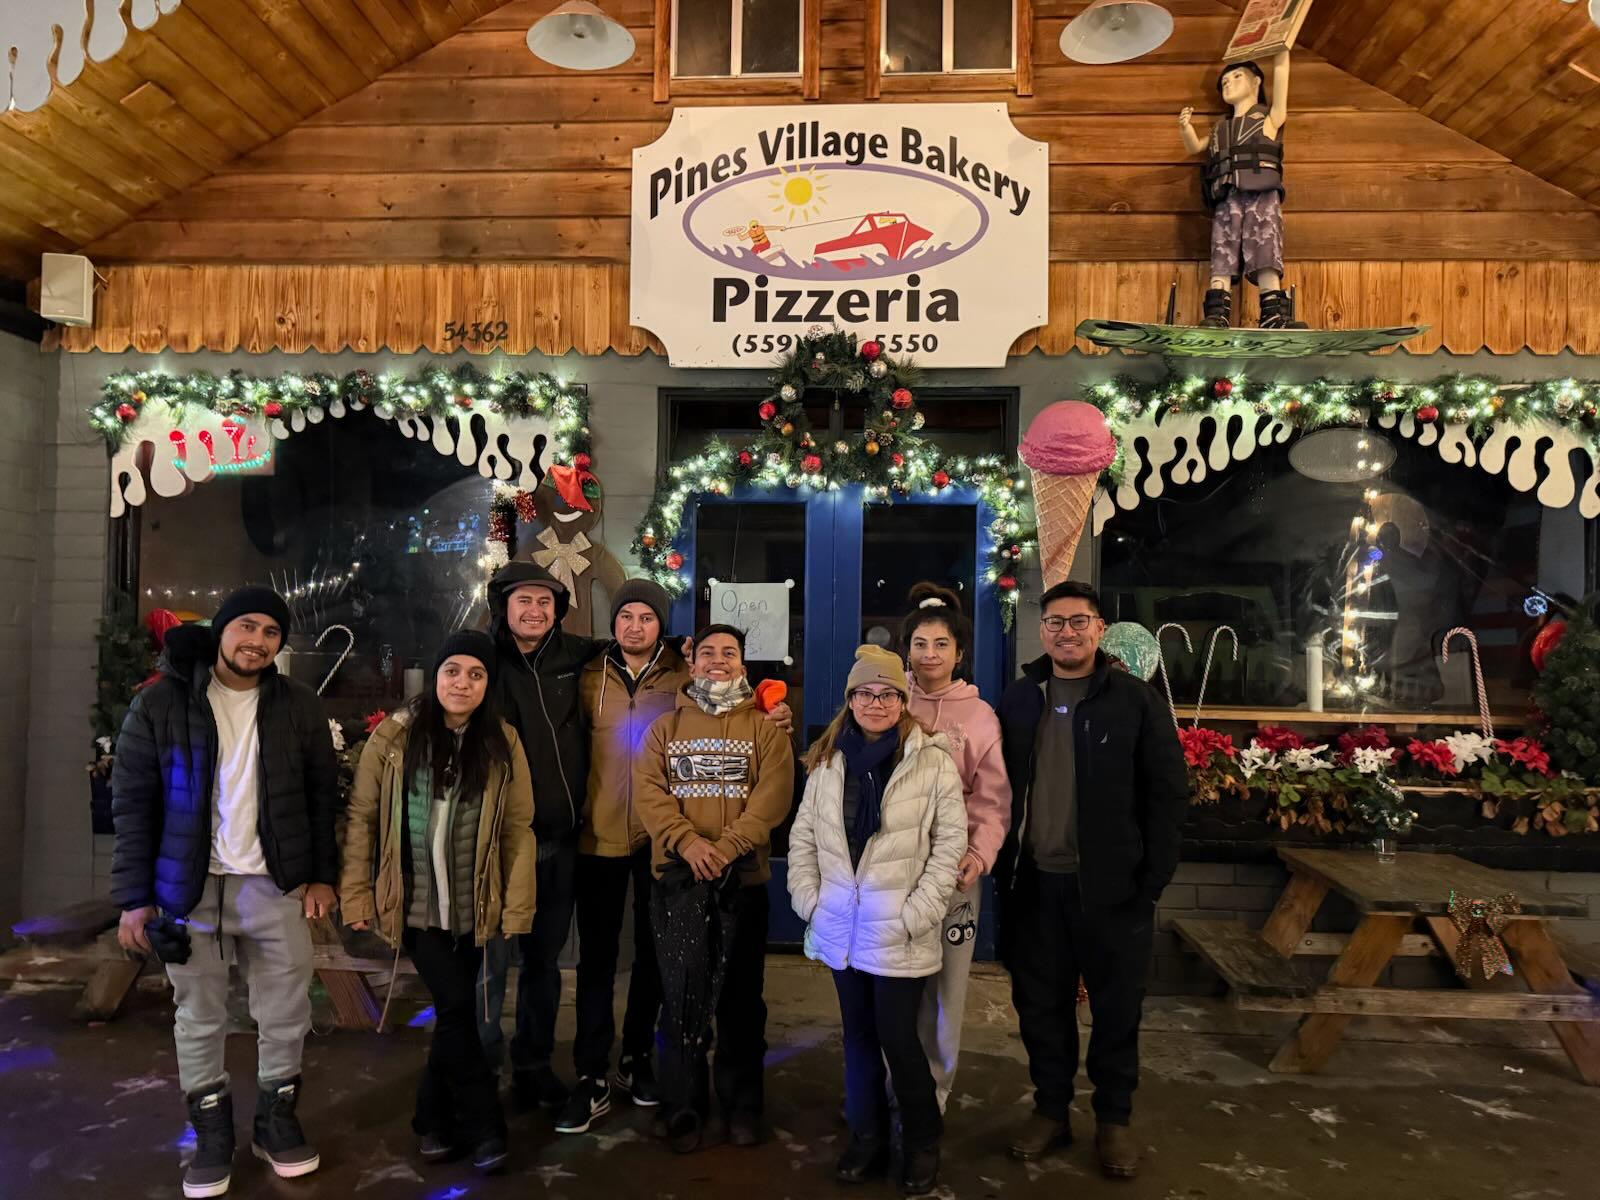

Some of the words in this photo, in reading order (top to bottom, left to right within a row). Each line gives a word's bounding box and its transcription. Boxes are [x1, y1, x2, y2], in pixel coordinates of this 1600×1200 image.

[650, 146, 748, 220] Pines
[758, 120, 888, 166] Village
[901, 126, 1031, 217] Bakery
[712, 274, 960, 324] Pizzeria
[442, 320, 508, 343] 54362
[721, 590, 768, 618] Open
